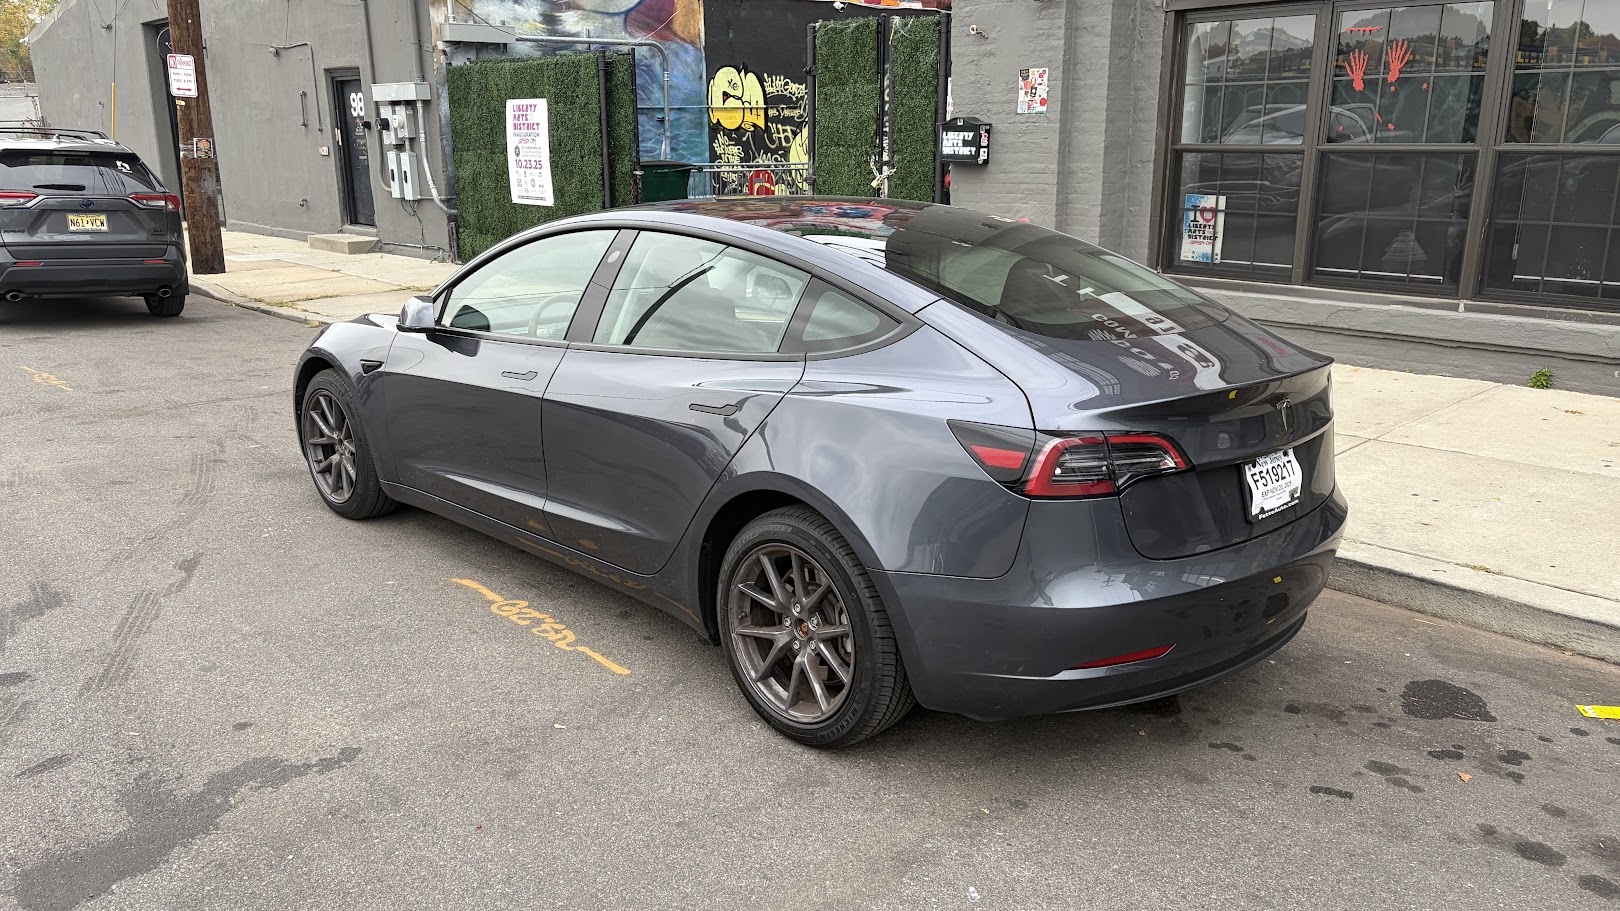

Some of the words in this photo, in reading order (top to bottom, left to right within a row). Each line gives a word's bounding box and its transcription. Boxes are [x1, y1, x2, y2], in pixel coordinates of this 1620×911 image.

[350, 92, 364, 117] 98
[512, 103, 537, 112] LIBERTY
[512, 113, 528, 121] ARTS
[512, 122, 540, 131] DISTRICT
[942, 131, 974, 141] LIBERTY
[942, 139, 963, 147] ARTS
[942, 146, 976, 155] DISTRICT
[515, 159, 543, 170] 10.23.25
[1250, 459, 1295, 490] F519217
[1258, 499, 1299, 520] FetteAuto.com
